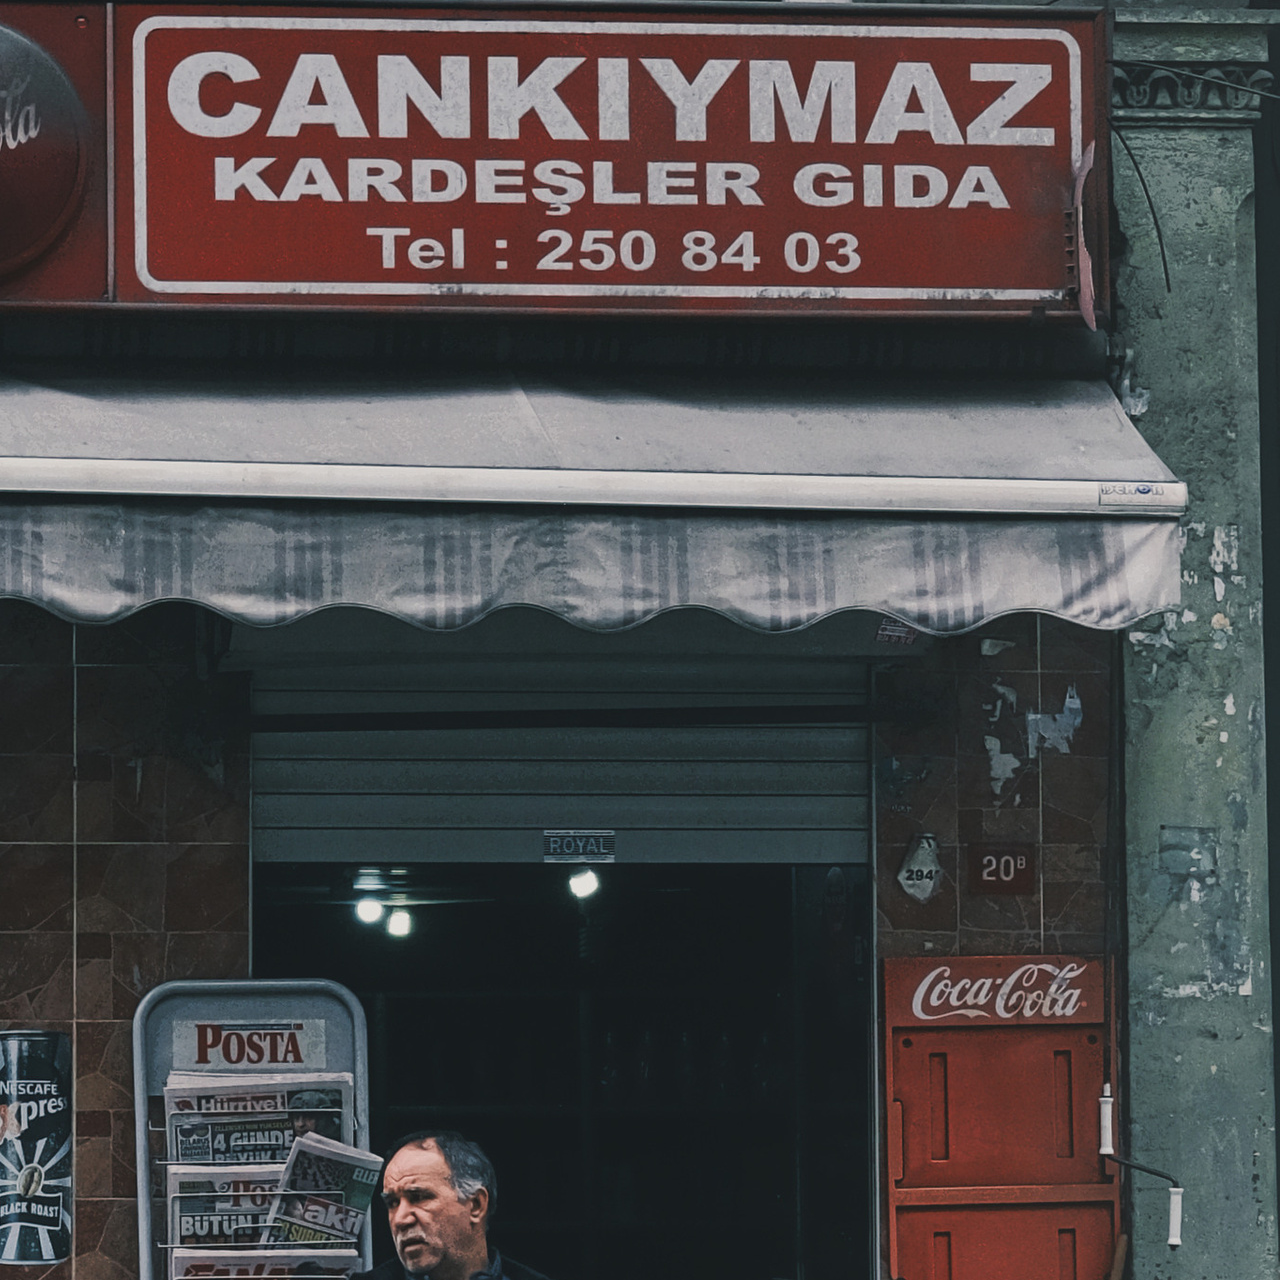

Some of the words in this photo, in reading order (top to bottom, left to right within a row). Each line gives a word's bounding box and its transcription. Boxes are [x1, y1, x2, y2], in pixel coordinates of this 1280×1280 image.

[167, 51, 1055, 146] CANKIYMAZ
[214, 157, 765, 216] KARDEŞLER
[793, 163, 1011, 209] GIDA
[366, 227, 465, 270] Tel
[536, 229, 656, 271] 250
[681, 231, 761, 272] 84
[784, 232, 862, 274] 03
[550, 837, 608, 853] ROYAL
[912, 963, 1086, 1020] Coca-Cola
[195, 1023, 303, 1065] POSTA
[214, 1133, 226, 1152] 4
[0, 1202, 28, 1217] BLACK
[30, 1202, 59, 1218] ROAST
[181, 1215, 252, 1236] BÜTÜN
